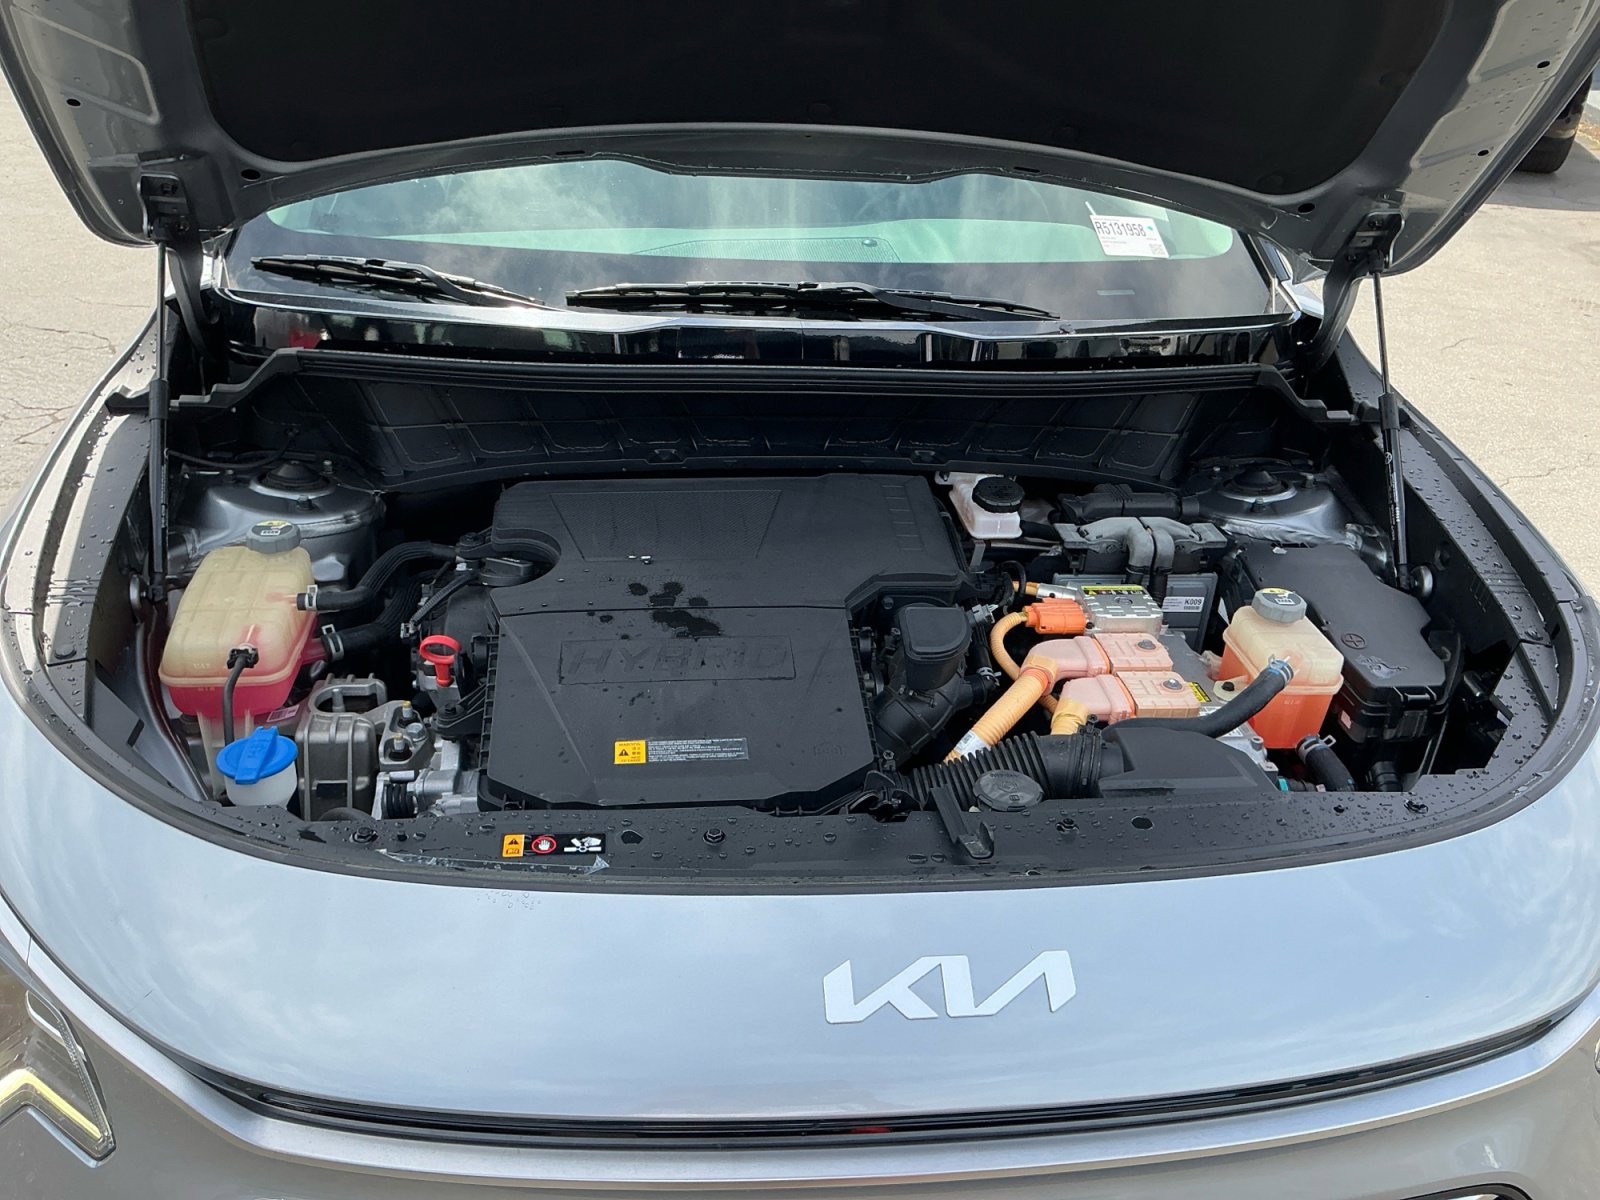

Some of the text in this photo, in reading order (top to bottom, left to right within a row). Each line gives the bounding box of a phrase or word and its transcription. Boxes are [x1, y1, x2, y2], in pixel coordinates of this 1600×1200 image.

[1094, 221, 1147, 237] R5131958
[1184, 598, 1202, 606] K009
[567, 644, 789, 674] HYBRID
[823, 950, 1076, 1024] KIA
